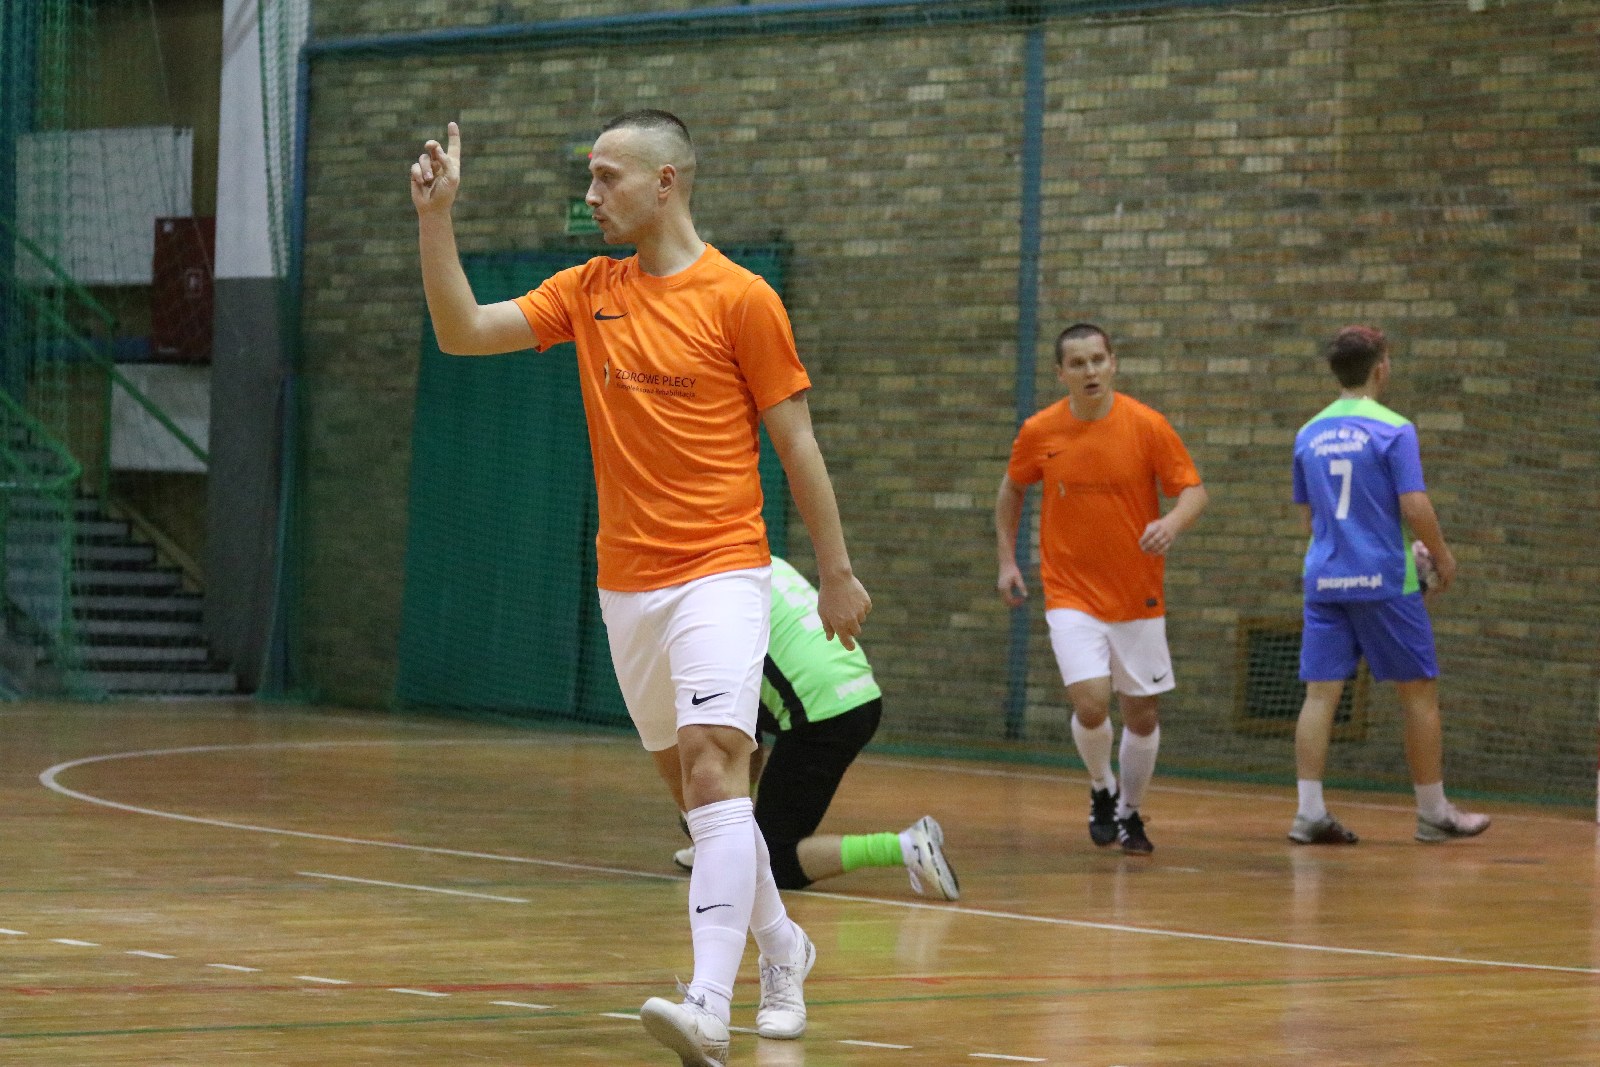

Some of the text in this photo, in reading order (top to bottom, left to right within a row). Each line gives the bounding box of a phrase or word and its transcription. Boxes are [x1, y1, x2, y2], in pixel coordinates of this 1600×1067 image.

[615, 369, 697, 388] ZDROWE PLECY
[1330, 460, 1352, 519] 7
